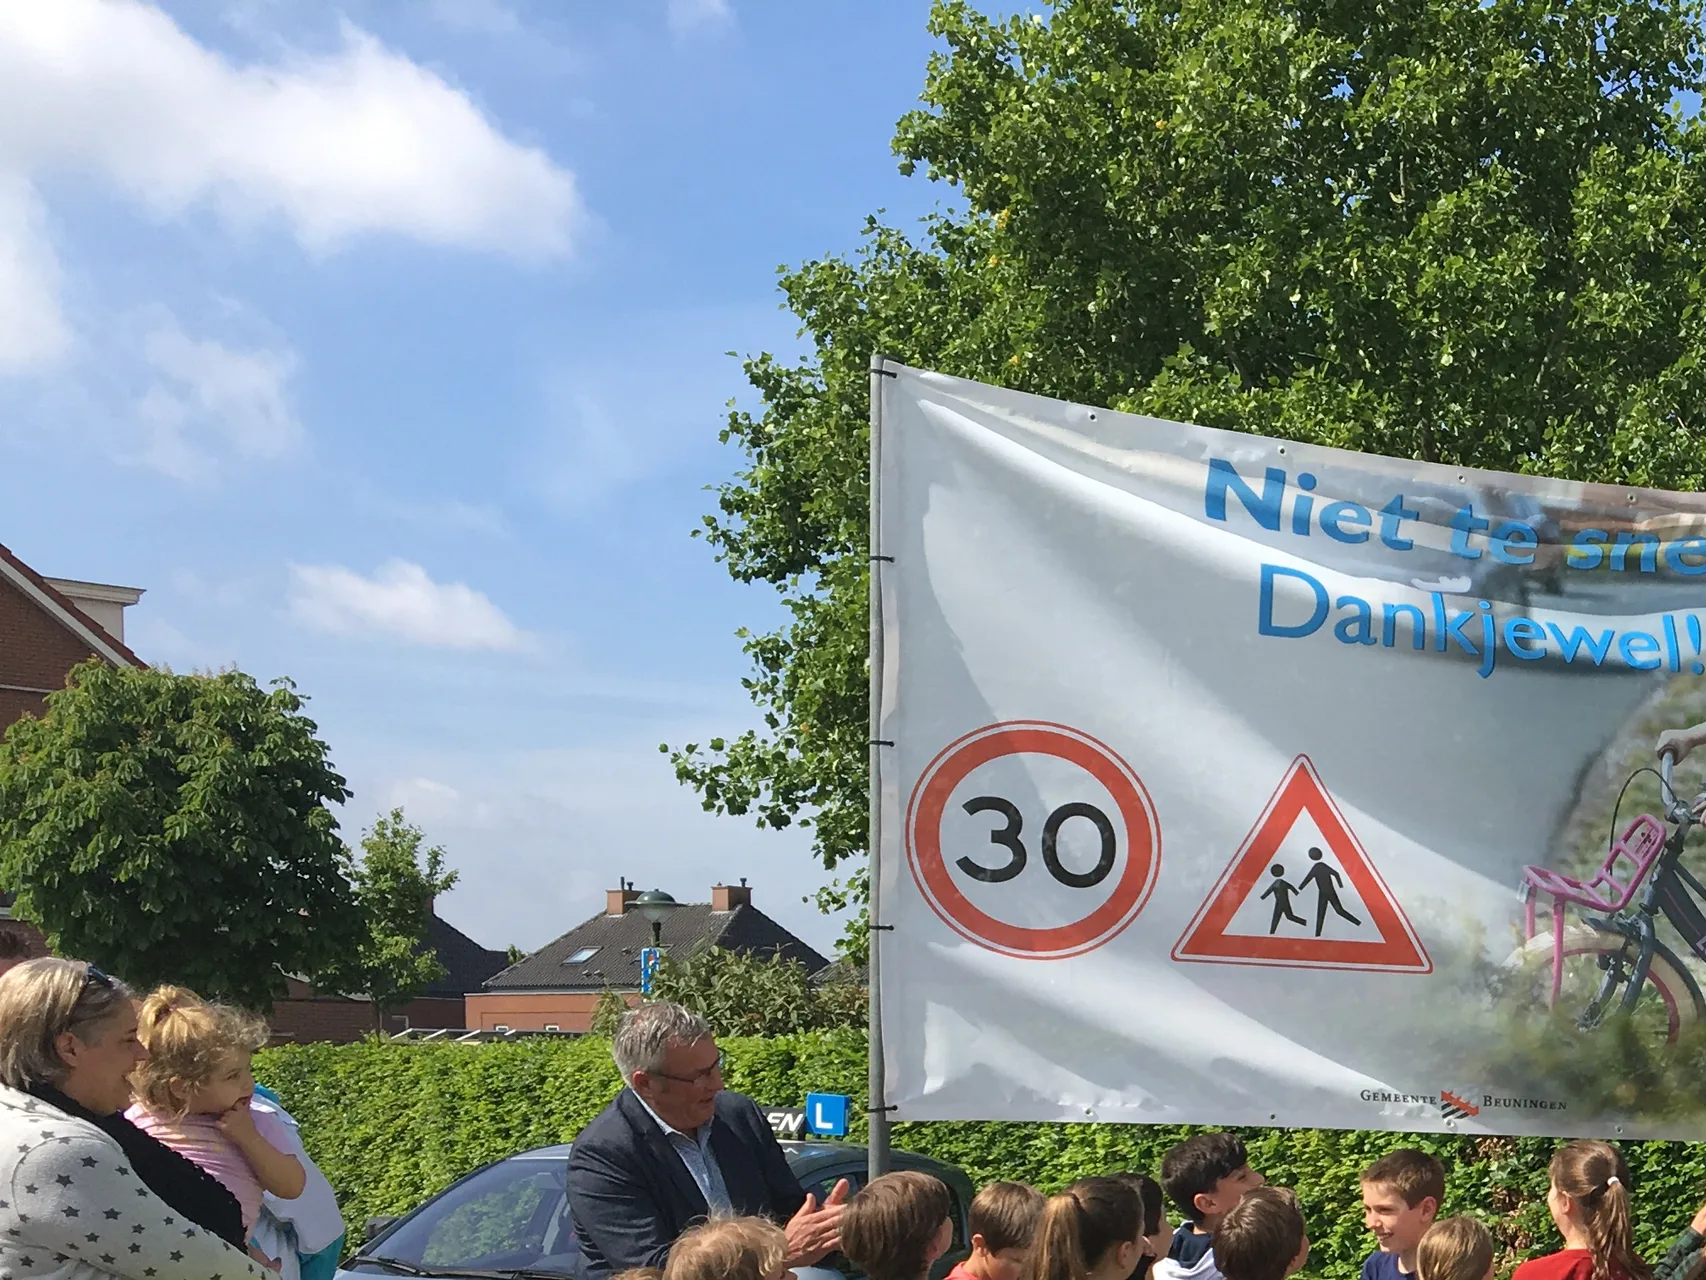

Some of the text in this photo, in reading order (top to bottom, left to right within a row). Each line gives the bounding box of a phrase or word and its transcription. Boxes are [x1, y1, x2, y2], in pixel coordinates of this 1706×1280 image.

[1203, 458, 1420, 551] Niet
[1449, 504, 1539, 565] te
[1258, 563, 1706, 679] Dankjewel!
[955, 796, 1116, 888] 30
[763, 1112, 804, 1132] EN
[815, 1102, 834, 1129] L
[1360, 1089, 1567, 1110] GEMEENTE BEUNINGEN
